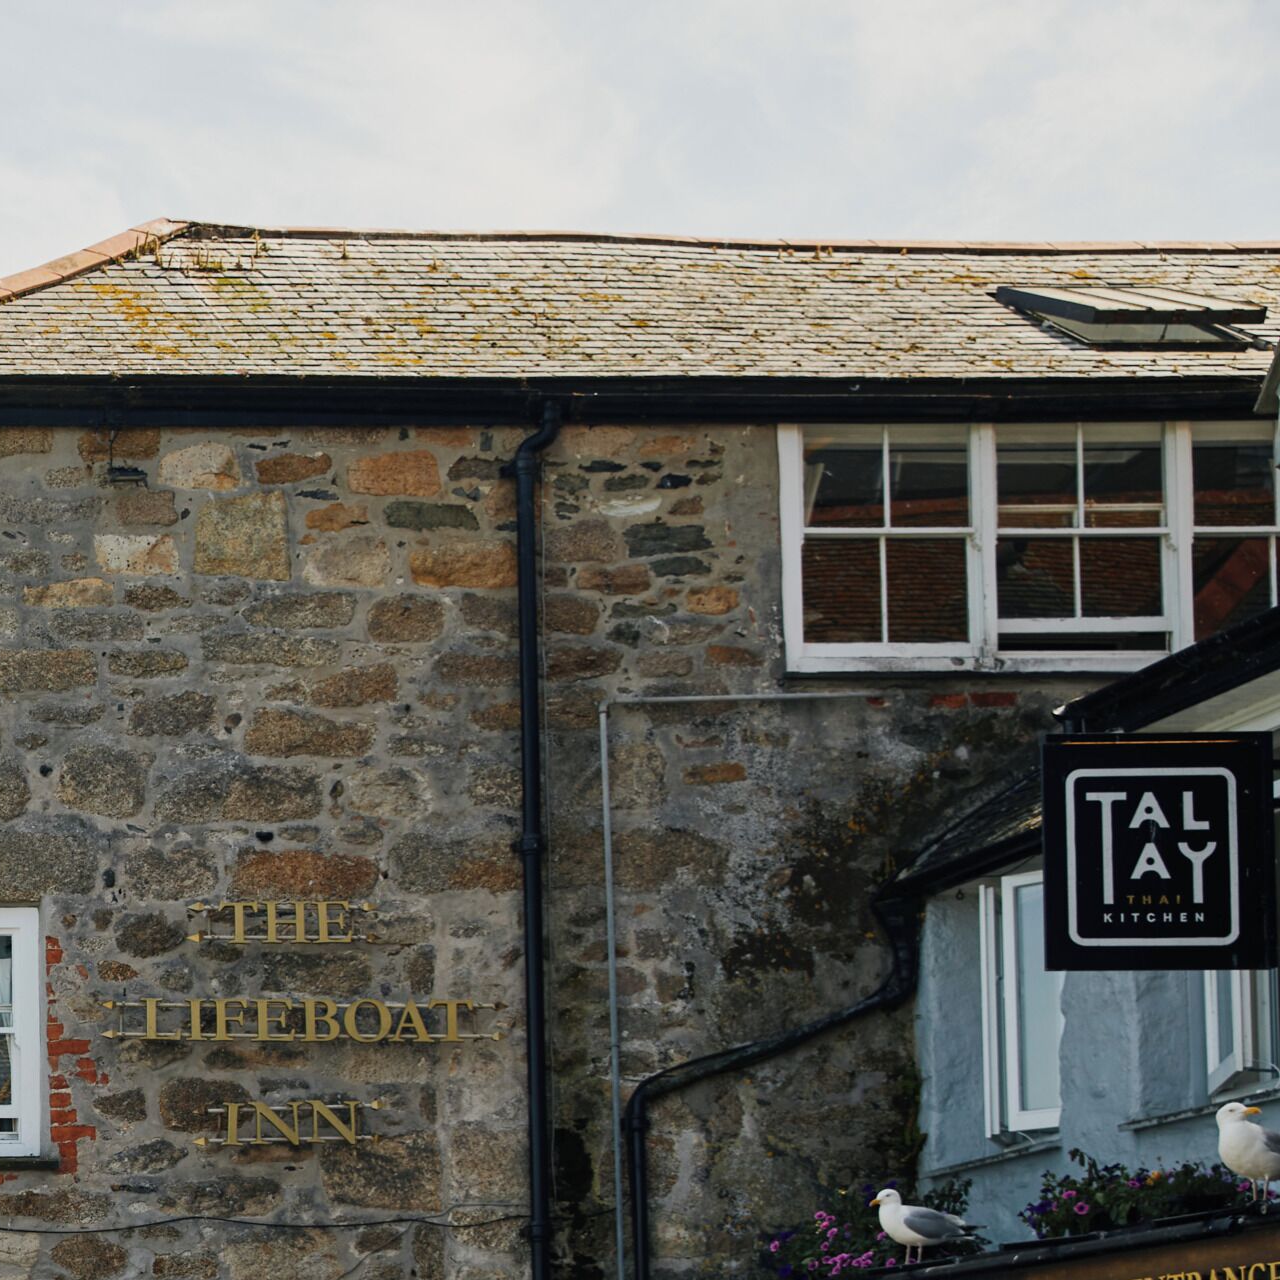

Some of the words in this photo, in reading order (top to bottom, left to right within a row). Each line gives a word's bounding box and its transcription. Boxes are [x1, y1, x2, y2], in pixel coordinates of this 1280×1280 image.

[219, 900, 354, 944] THE
[1103, 912, 1205, 923] KITCHEN
[1126, 895, 1182, 905] THAI
[140, 998, 474, 1043] LIFEBOAT
[222, 1100, 360, 1146] INN
